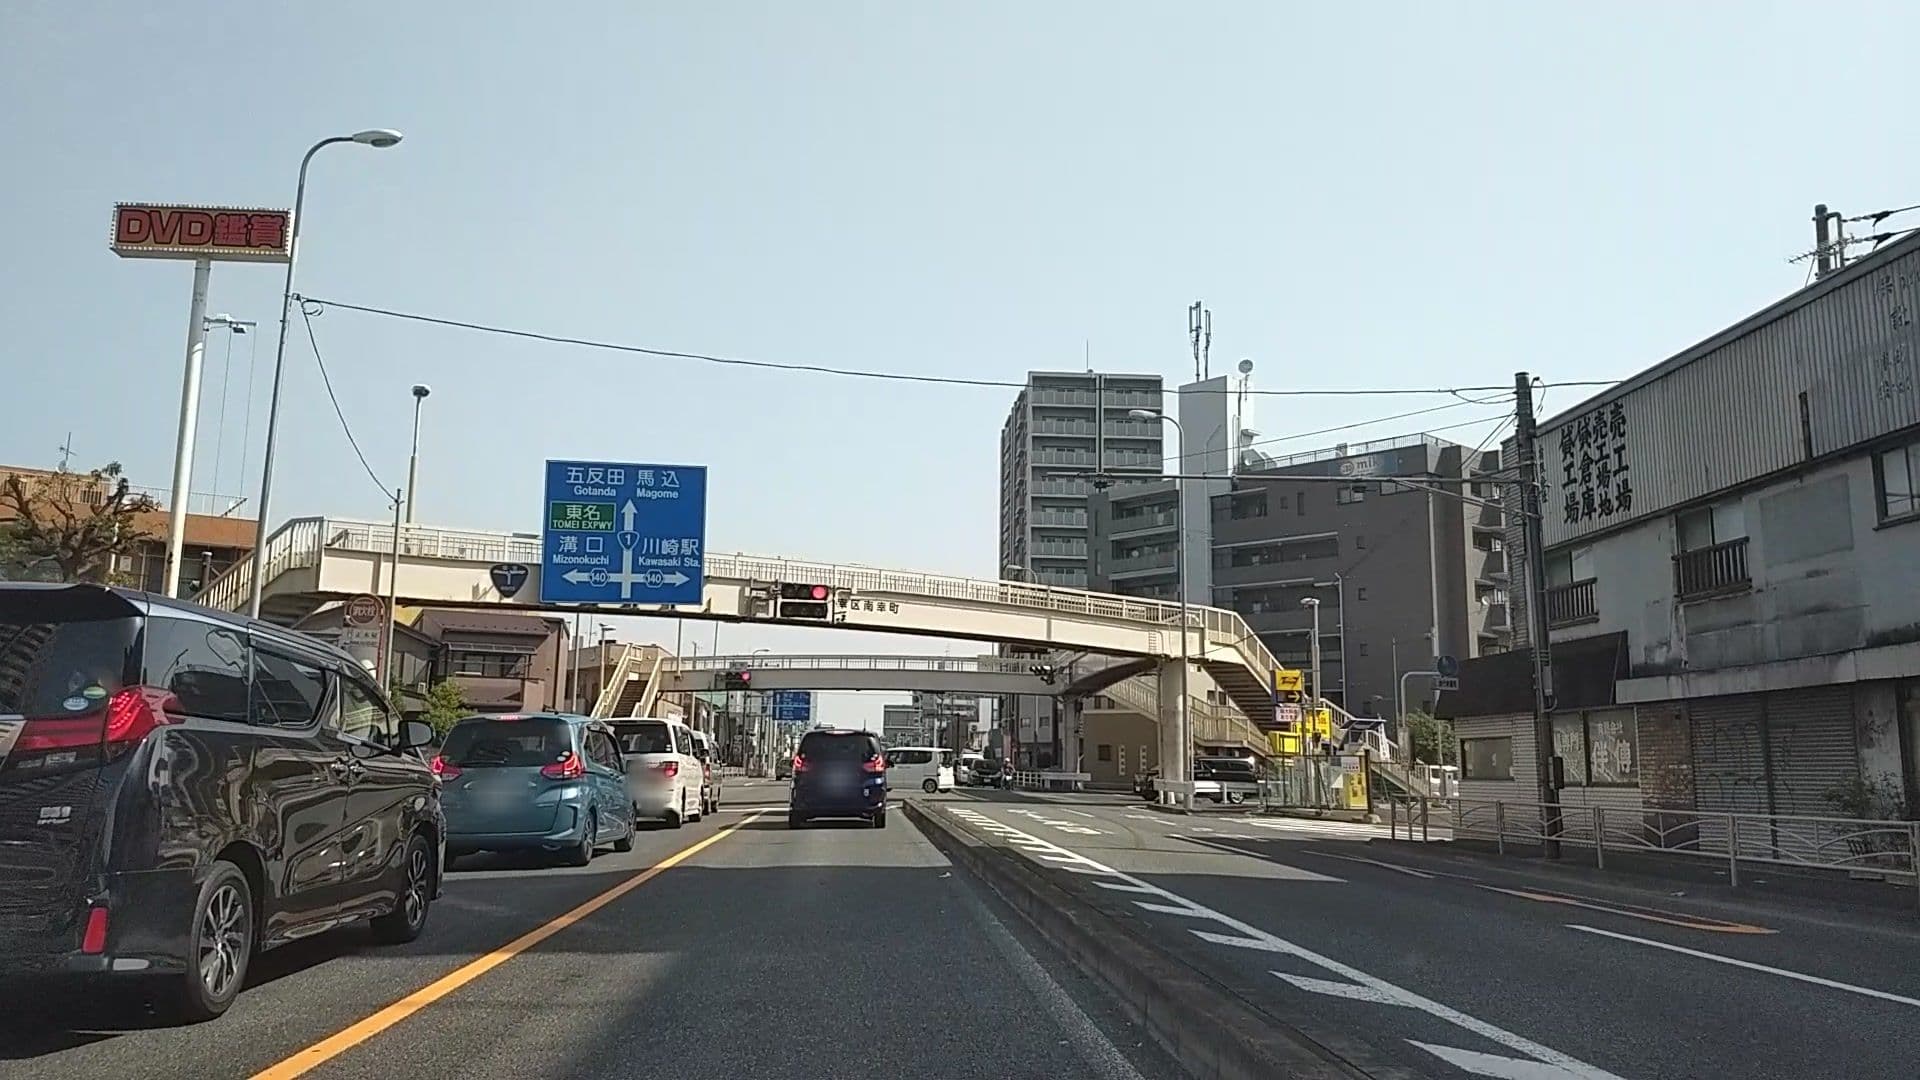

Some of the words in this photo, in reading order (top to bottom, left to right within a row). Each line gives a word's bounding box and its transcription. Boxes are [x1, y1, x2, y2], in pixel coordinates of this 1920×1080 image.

[117, 209, 285, 248] DVD鑑賞
[1610, 401, 1632, 513] 売工場
[566, 467, 625, 485] 五反田
[637, 470, 680, 487] 馬込
[574, 485, 617, 496] Gotanda
[637, 488, 679, 499] Magome
[566, 504, 601, 521] 東名
[553, 520, 580, 529] TOMEI
[582, 521, 613, 530] EXPWY
[559, 535, 604, 553] 溝口
[625, 534, 632, 546] 1
[642, 538, 700, 556] 川崎駅
[553, 555, 610, 565] Mizonokuchi
[639, 557, 681, 567] Kawasaki
[683, 557, 701, 567] Sta.
[591, 573, 606, 582] 140
[646, 574, 662, 583] 140
